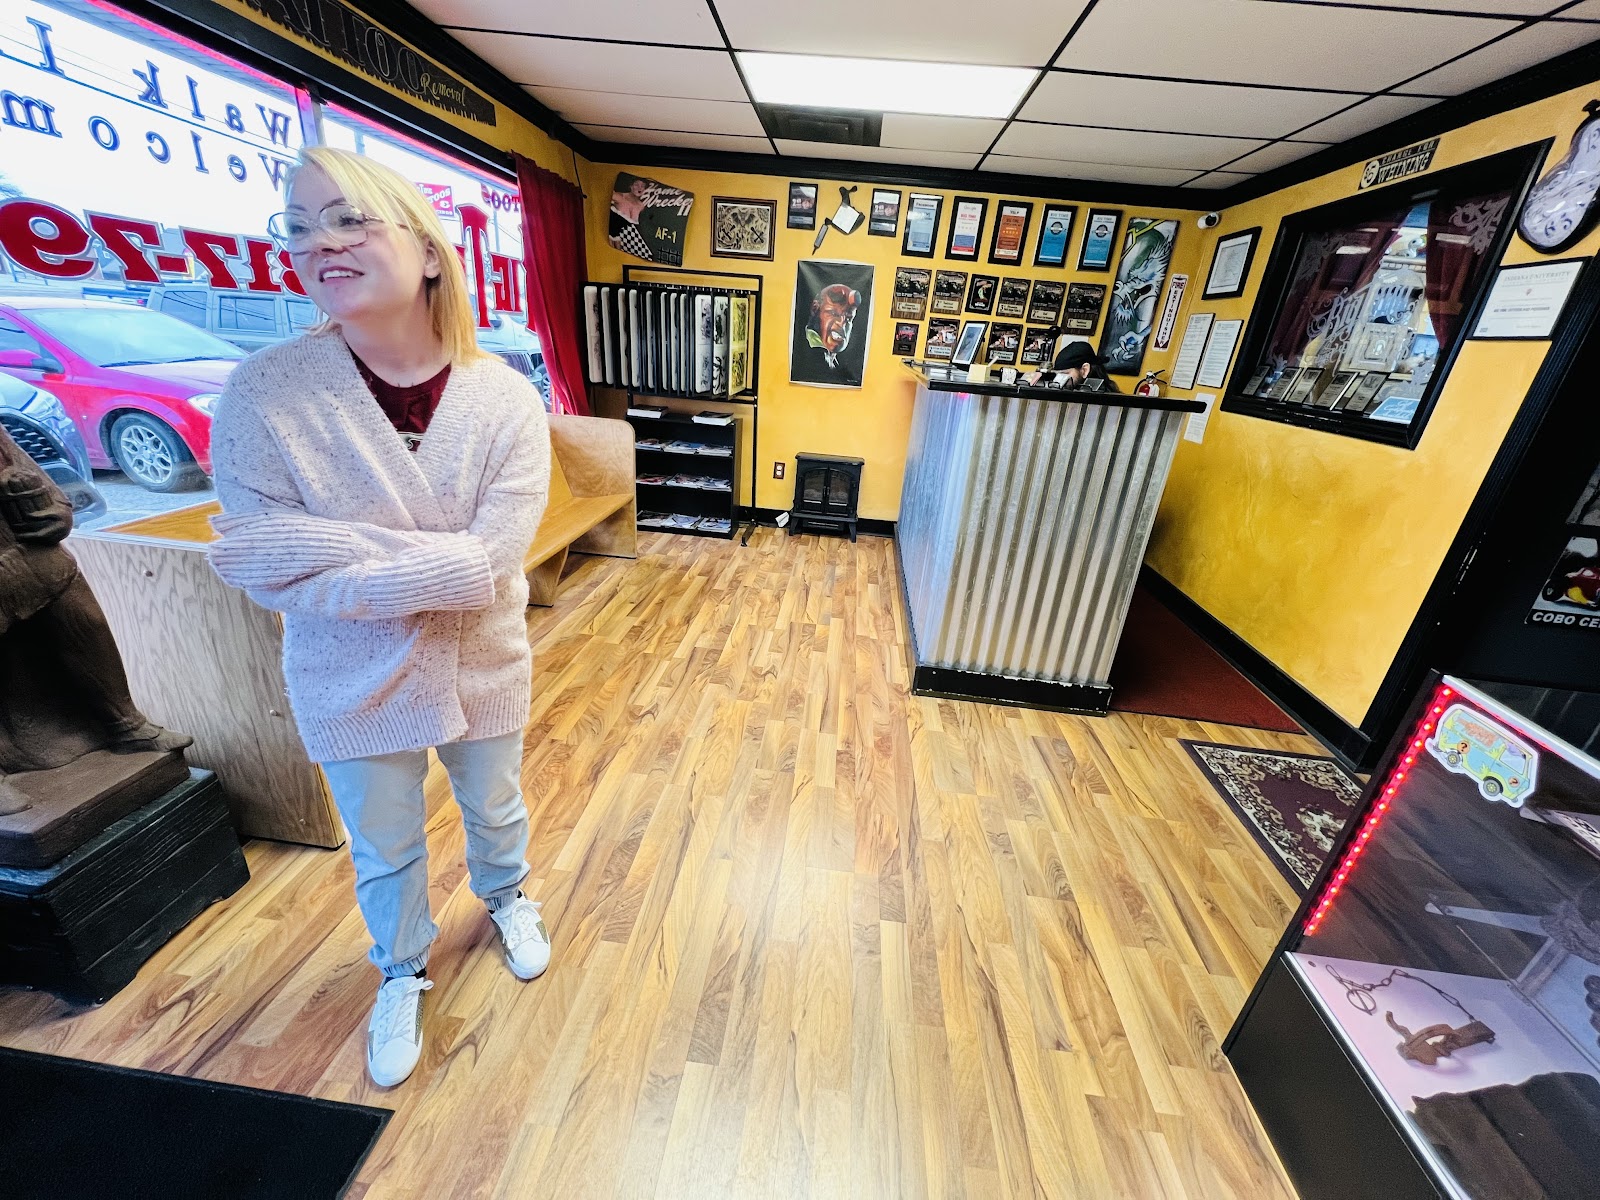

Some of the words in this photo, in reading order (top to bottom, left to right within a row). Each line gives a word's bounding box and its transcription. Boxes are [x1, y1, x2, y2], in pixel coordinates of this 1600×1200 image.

[420, 72, 466, 107] Removal
[1382, 149, 1412, 164] CHARGE
[1418, 141, 1435, 152] FOR
[1378, 152, 1431, 184] WHINING
[642, 182, 684, 197] Home
[655, 226, 677, 244] AF-1
[1160, 289, 1179, 345] EXTINGUISHER
[1532, 611, 1576, 625] COBO
[1579, 616, 1600, 628] CE
